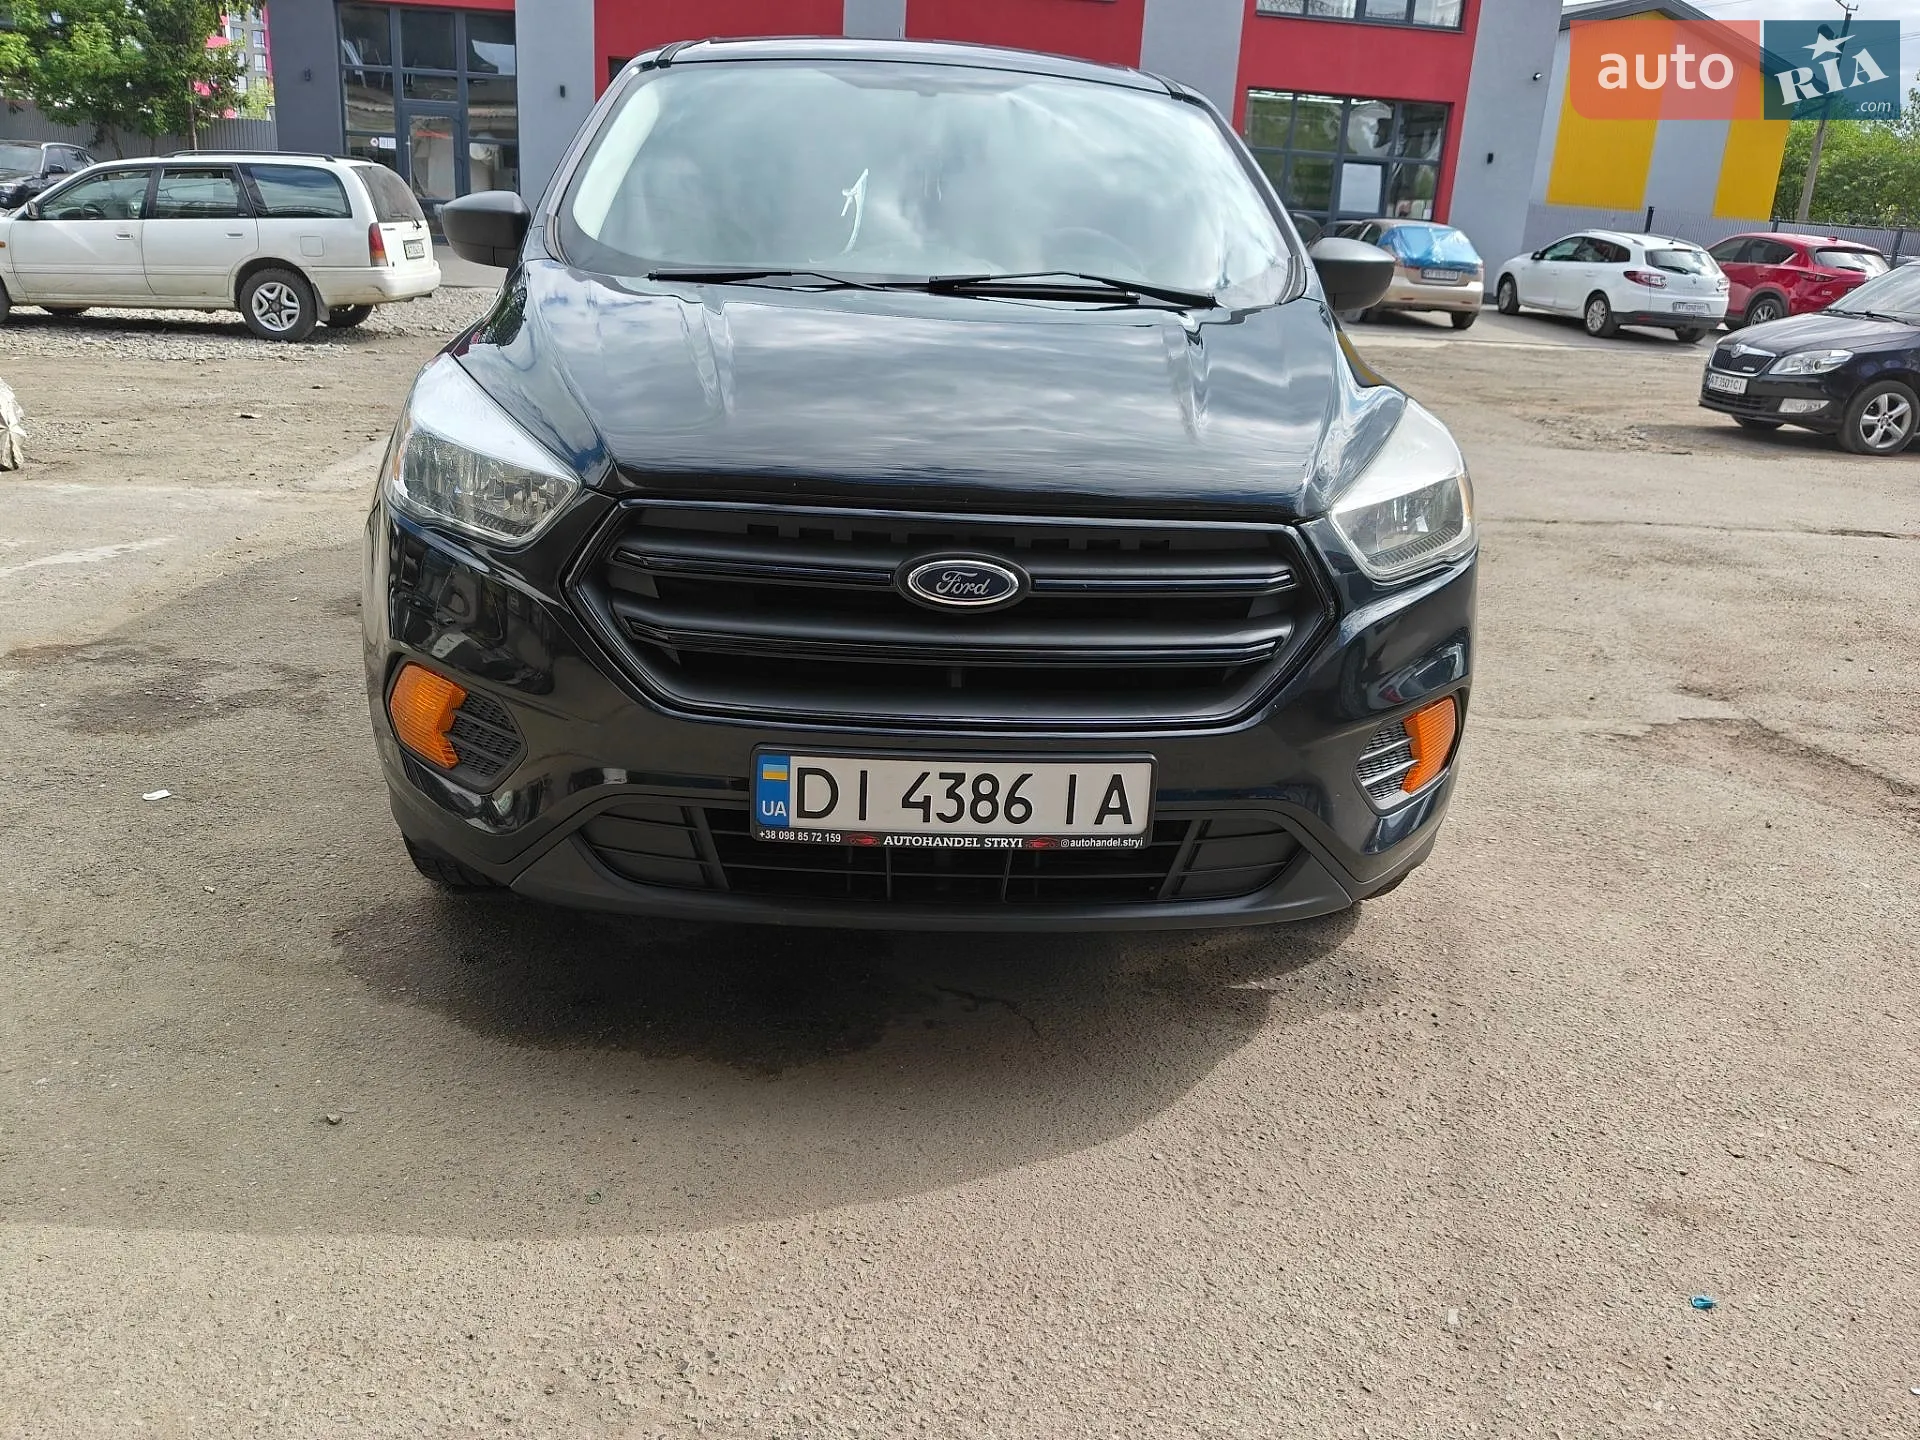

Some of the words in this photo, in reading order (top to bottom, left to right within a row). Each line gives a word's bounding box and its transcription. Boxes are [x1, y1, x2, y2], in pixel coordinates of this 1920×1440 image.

[936, 570, 990, 595] Ford
[797, 767, 868, 821] DI
[901, 771, 1034, 824] 4386
[1065, 773, 1133, 825] IA
[762, 800, 787, 817] UA
[759, 831, 776, 840] +38
[778, 831, 795, 841] 098
[797, 832, 809, 842] 85
[811, 832, 822, 842] 72
[824, 833, 841, 843] 159
[883, 836, 981, 847] AUTOHANDEL
[984, 837, 1023, 848] STRYI
